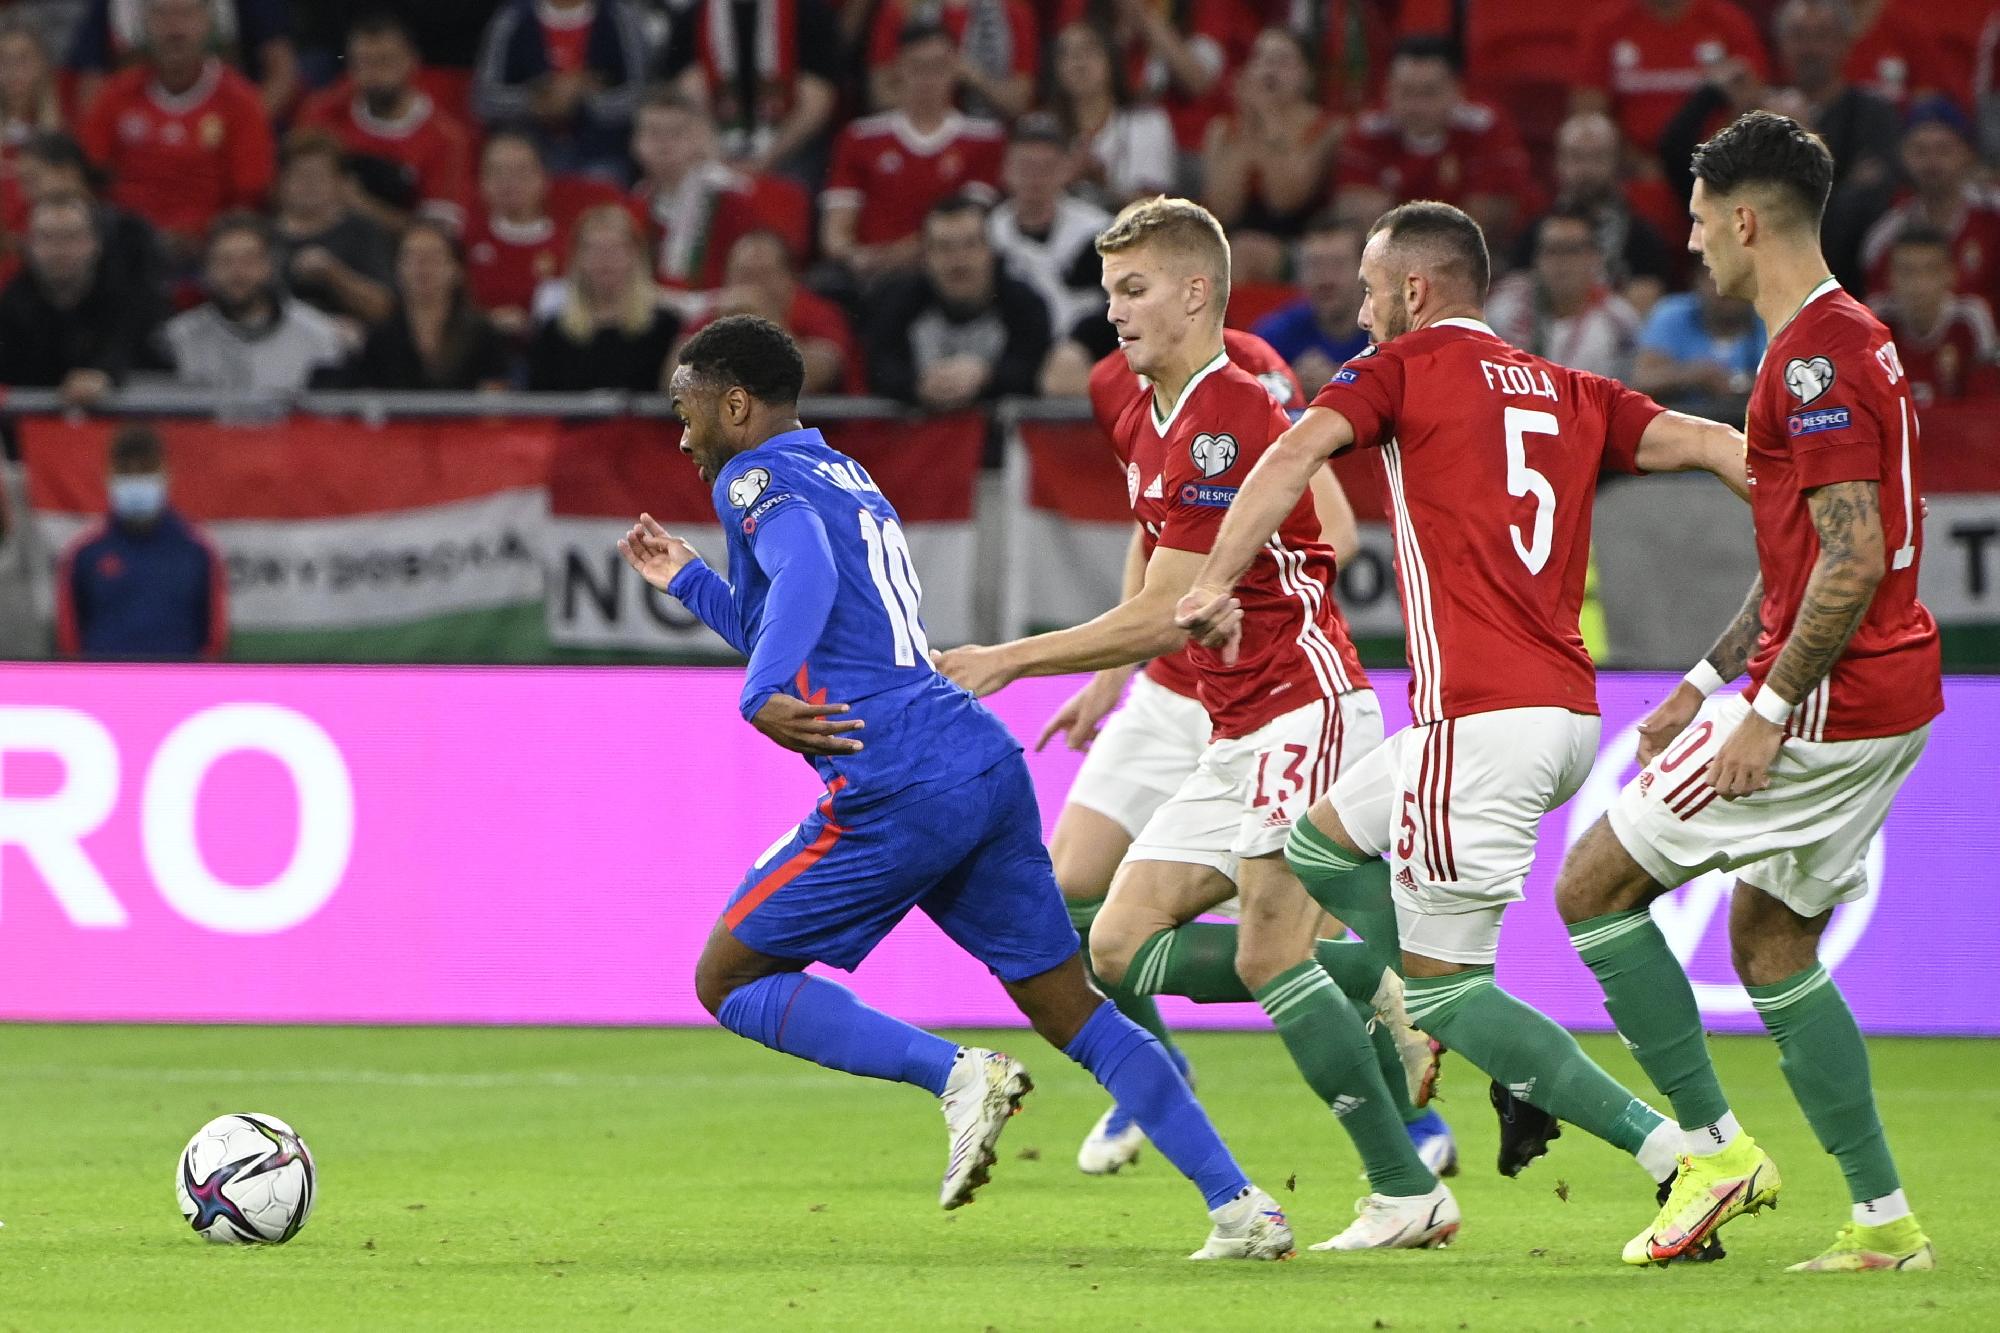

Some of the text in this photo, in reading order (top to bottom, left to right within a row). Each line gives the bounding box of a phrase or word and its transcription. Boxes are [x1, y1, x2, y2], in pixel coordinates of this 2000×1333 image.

[1480, 360, 1558, 401] FIOLA
[1802, 411, 1849, 427] RESPECT
[751, 493, 792, 520] RESPECT
[1199, 491, 1236, 502] RESPEC
[1504, 406, 1559, 576] 5
[1892, 397, 1920, 570] 1
[858, 508, 936, 672] 10
[1252, 743, 1308, 808] 13
[1397, 791, 1417, 860] 5
